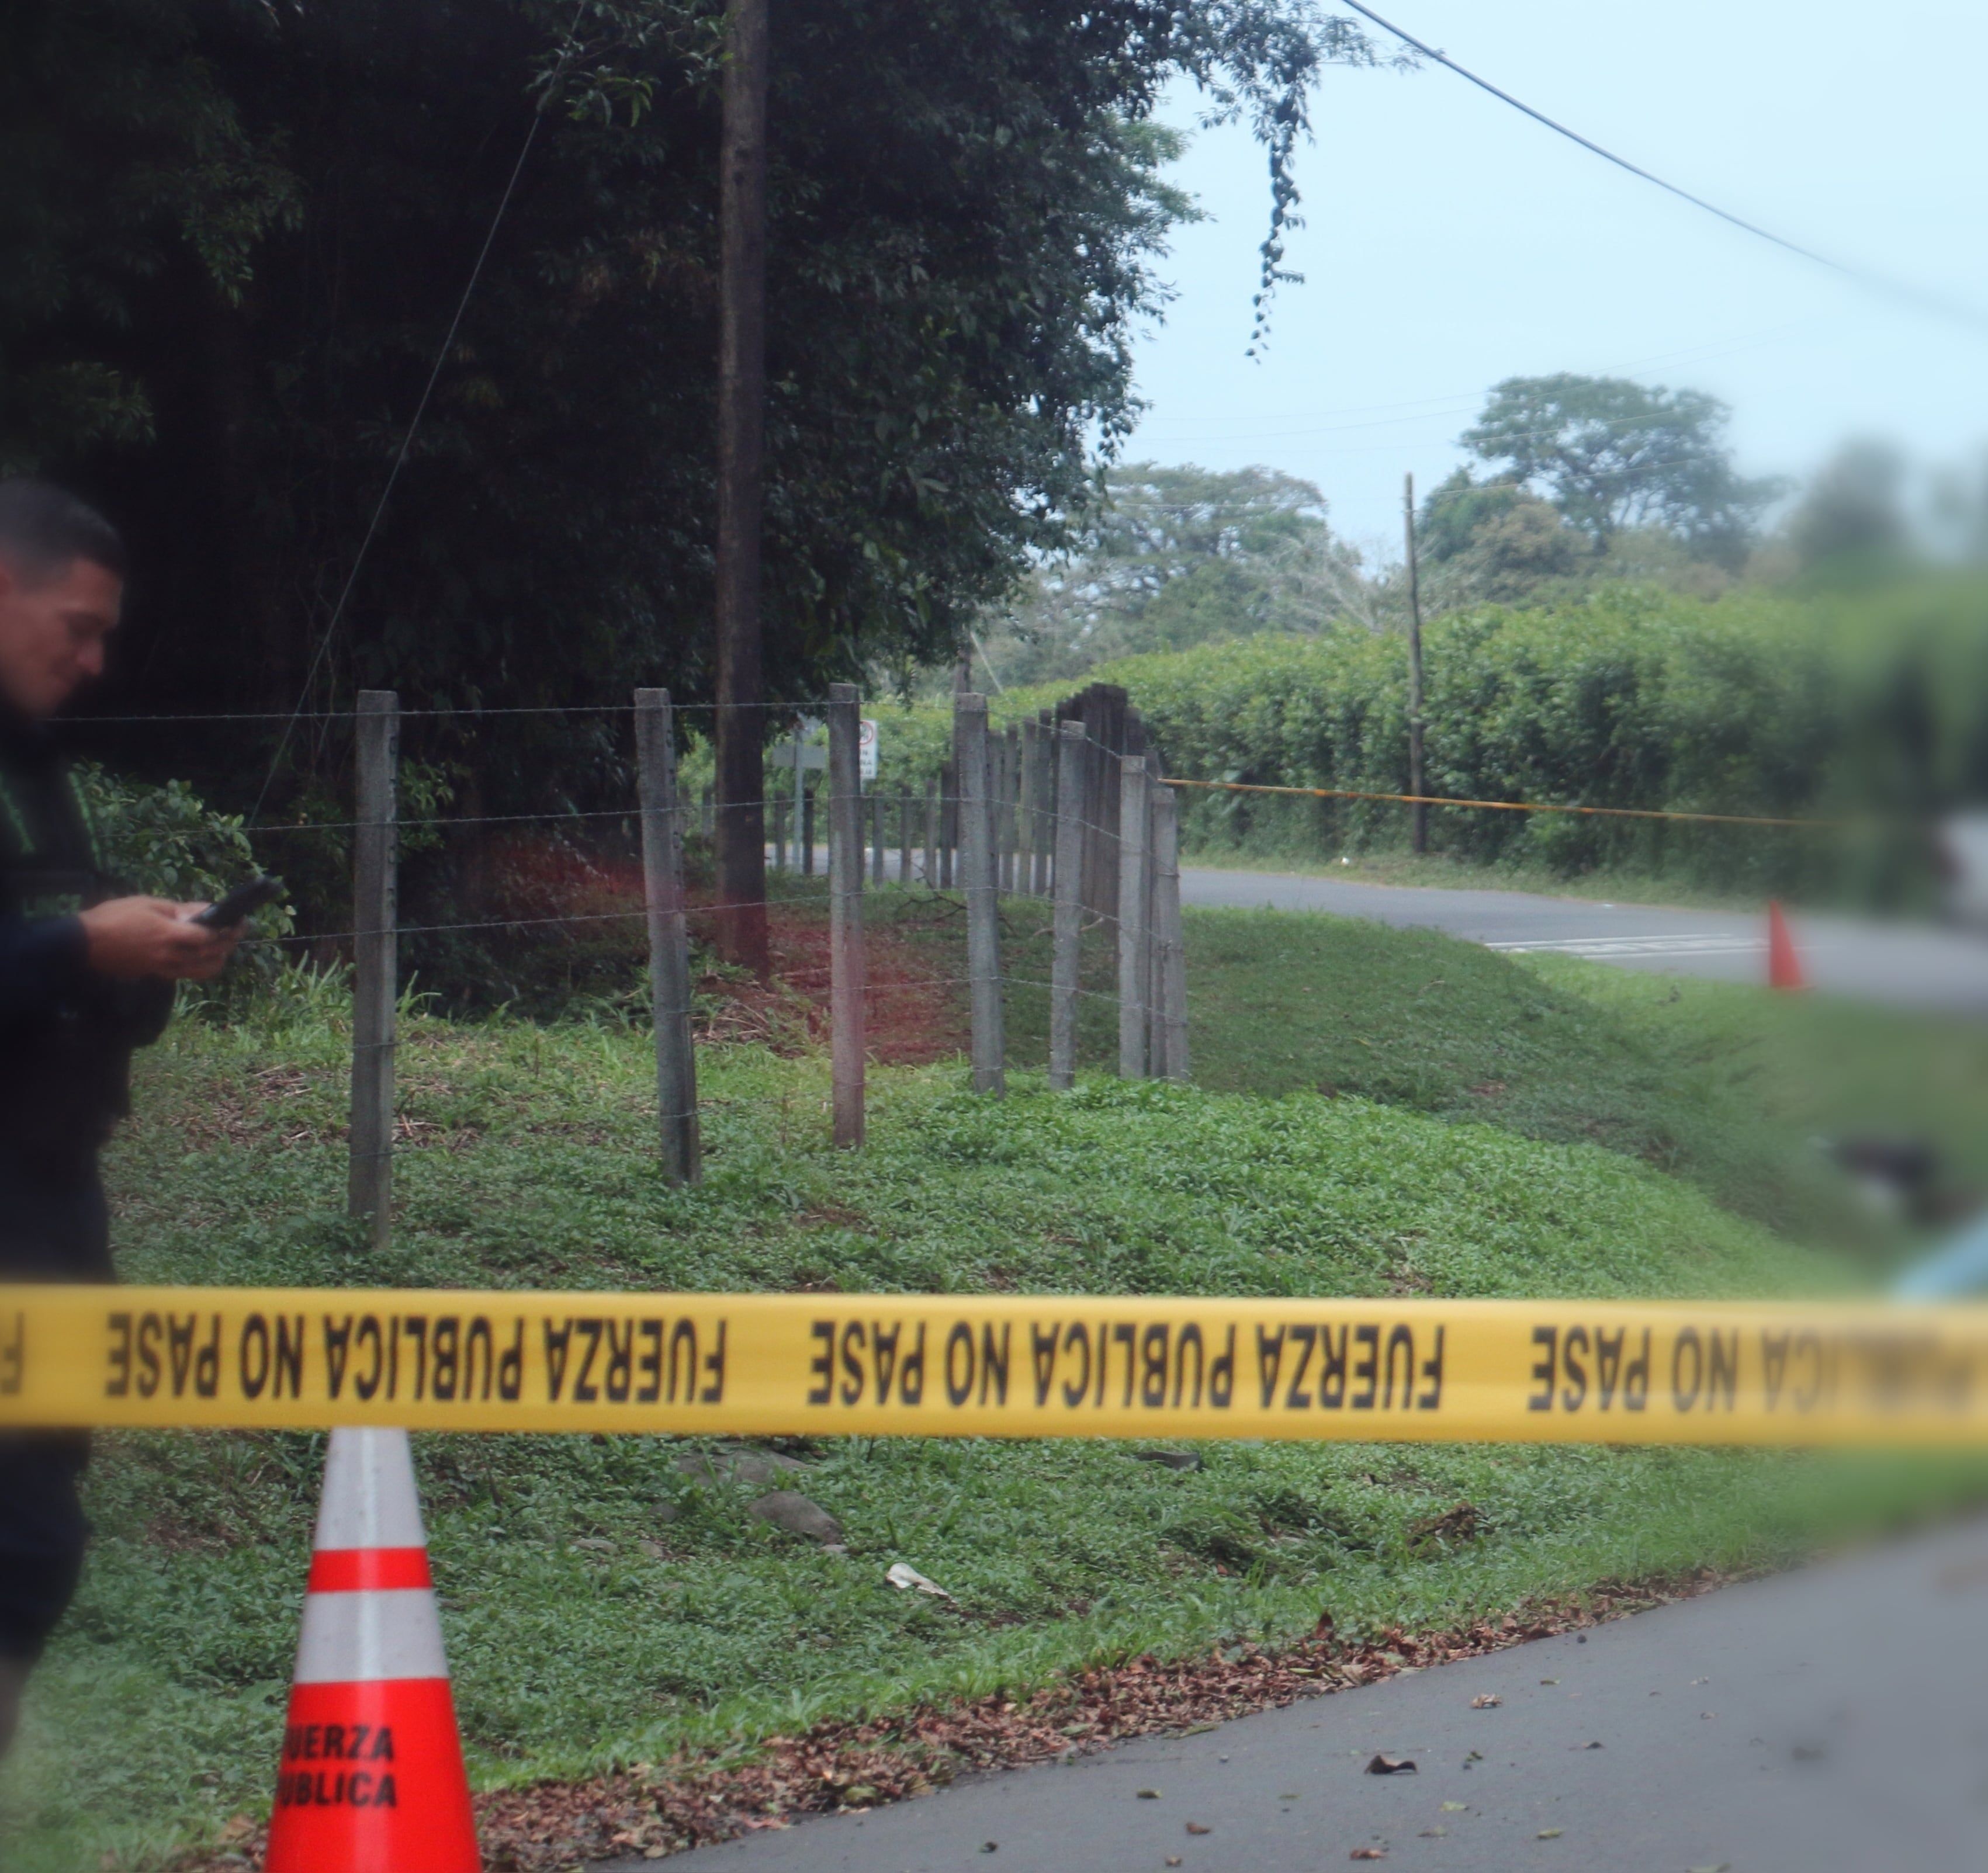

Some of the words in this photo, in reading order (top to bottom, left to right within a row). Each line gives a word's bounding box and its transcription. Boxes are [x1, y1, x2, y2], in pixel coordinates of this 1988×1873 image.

[104, 1310, 223, 1400] PASE
[237, 1312, 306, 1402] NO
[321, 1313, 525, 1403] PUBLICA
[542, 1316, 728, 1404] FUERZA
[807, 1319, 927, 1406] PASE
[943, 1320, 1012, 1407] NO
[1030, 1321, 1237, 1409] PUBLICA
[1256, 1324, 1445, 1410] FUERZA
[1528, 1325, 1652, 1413] PASE
[1671, 1326, 1740, 1413] NO
[283, 1723, 394, 1762] UERZA
[277, 1771, 397, 1808] UBLICA
